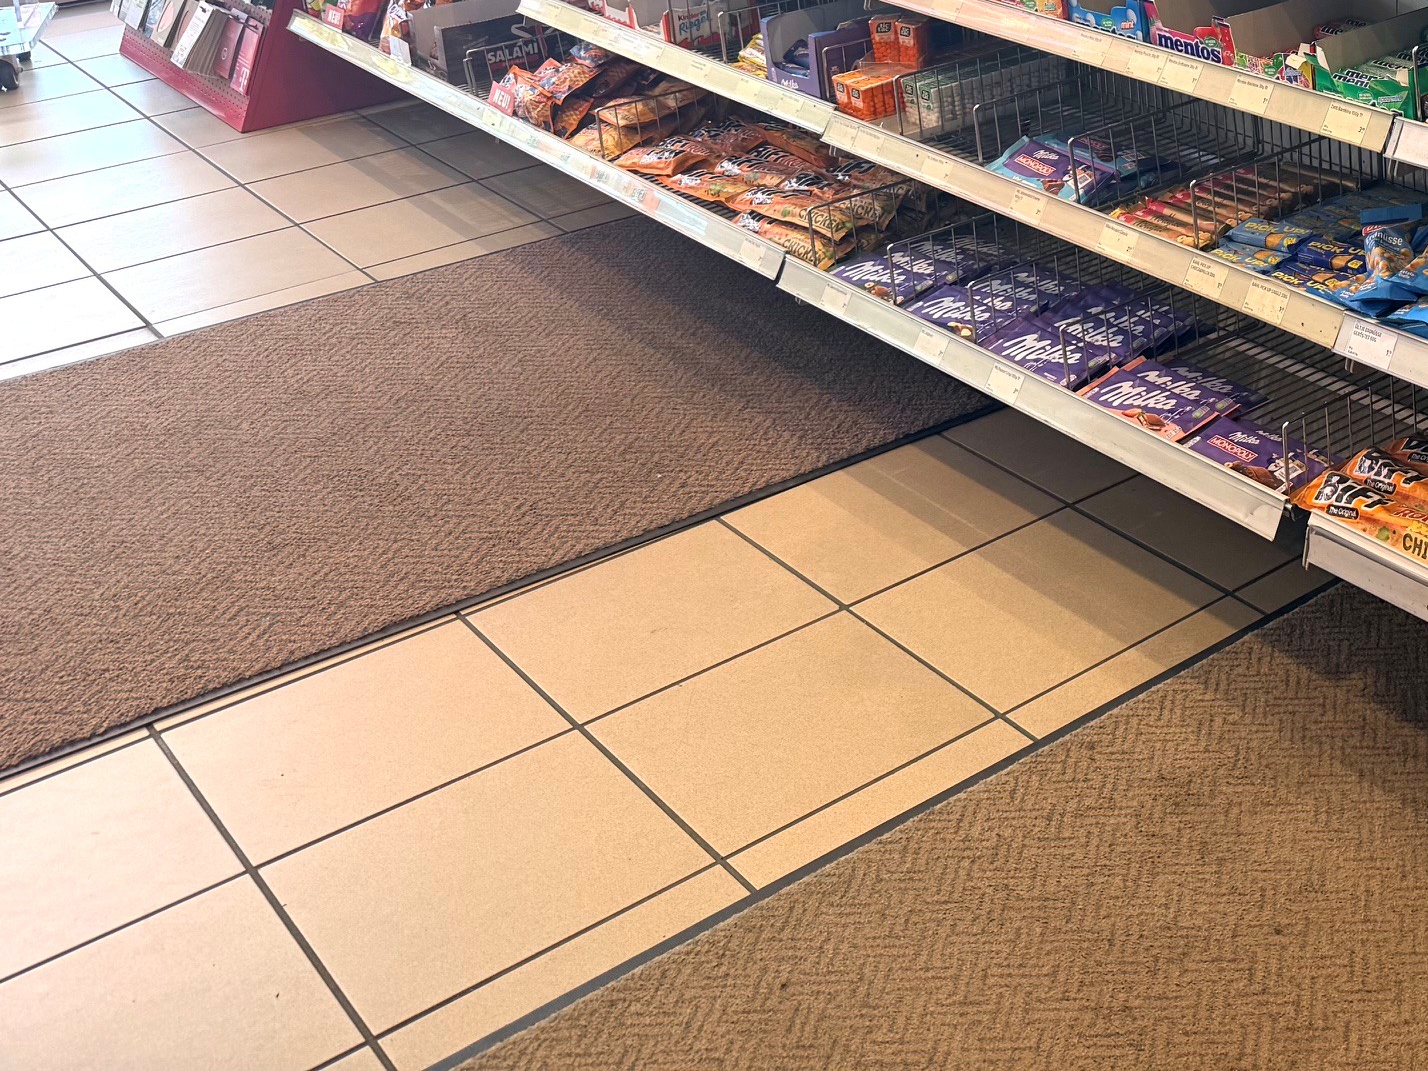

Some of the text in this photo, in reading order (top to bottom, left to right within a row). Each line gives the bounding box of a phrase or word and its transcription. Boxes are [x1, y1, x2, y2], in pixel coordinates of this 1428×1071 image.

[487, 41, 539, 64] SALAMI
[1157, 32, 1223, 64] mentos
[492, 89, 512, 109] NEU!
[1099, 380, 1176, 409] Milka
[1212, 437, 1256, 462] MONOPOLY
[1229, 430, 1261, 445] Milka
